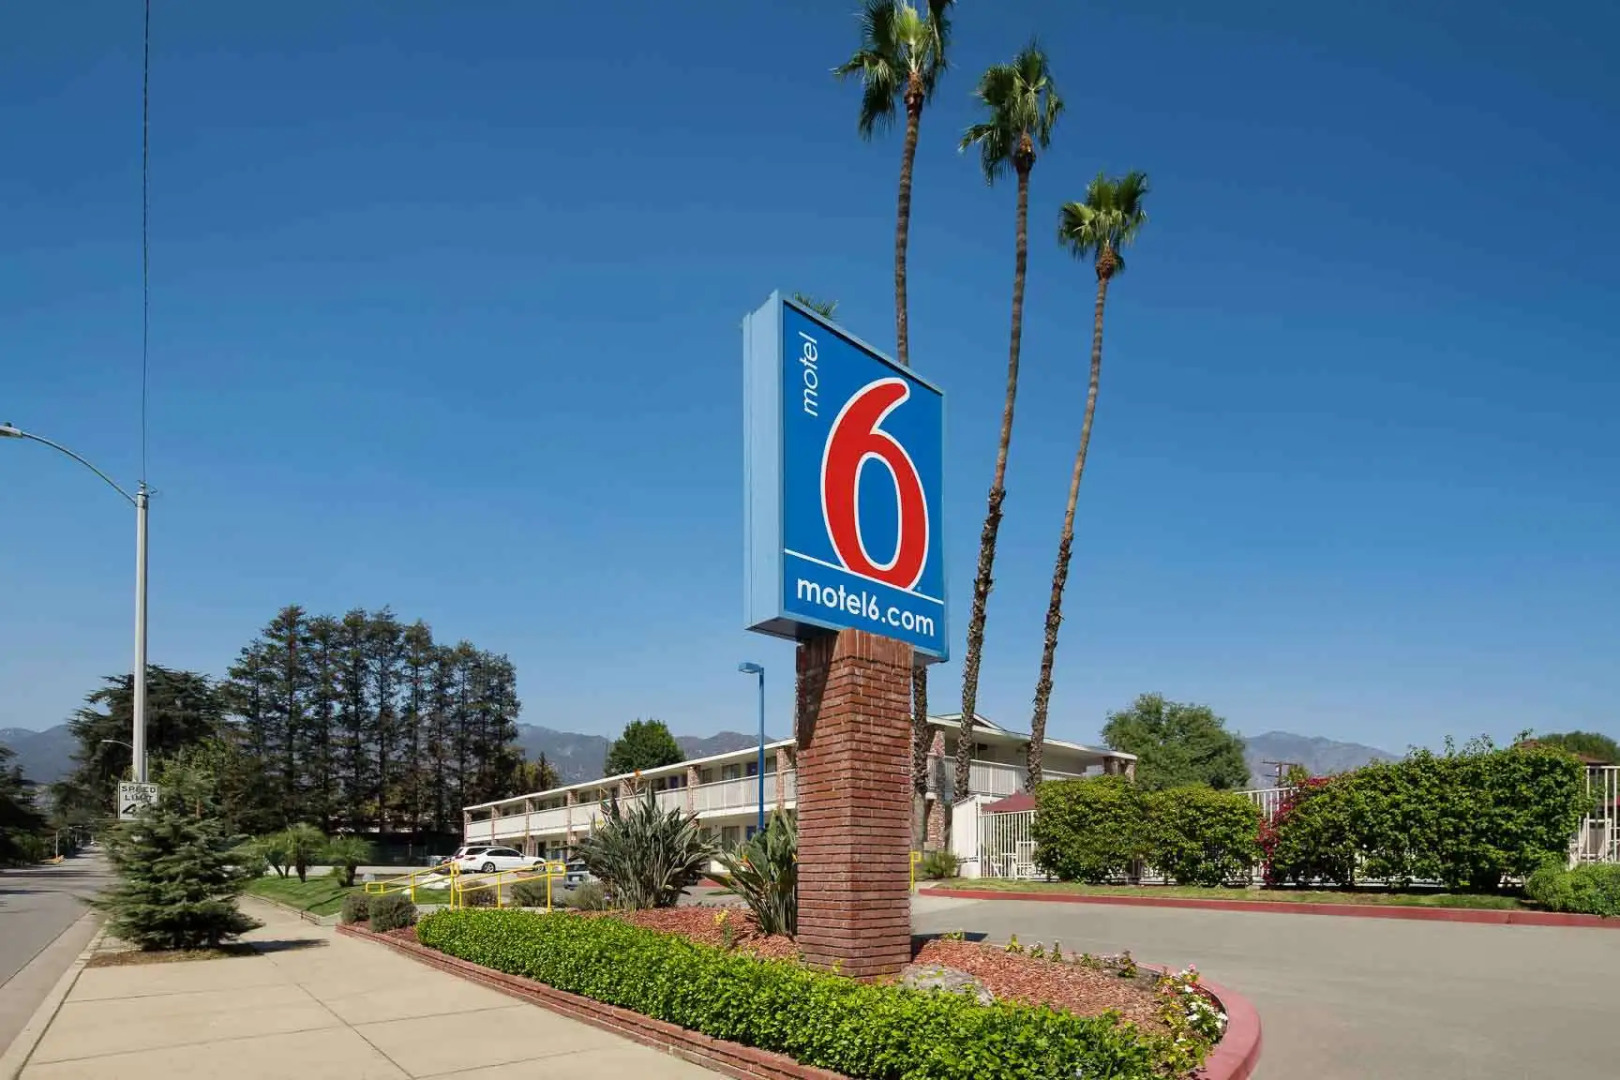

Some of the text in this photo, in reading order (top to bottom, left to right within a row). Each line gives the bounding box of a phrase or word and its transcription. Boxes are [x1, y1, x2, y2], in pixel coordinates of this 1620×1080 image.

[799, 332, 818, 417] motel
[821, 377, 929, 592] 6
[797, 578, 934, 636] motel6.com
